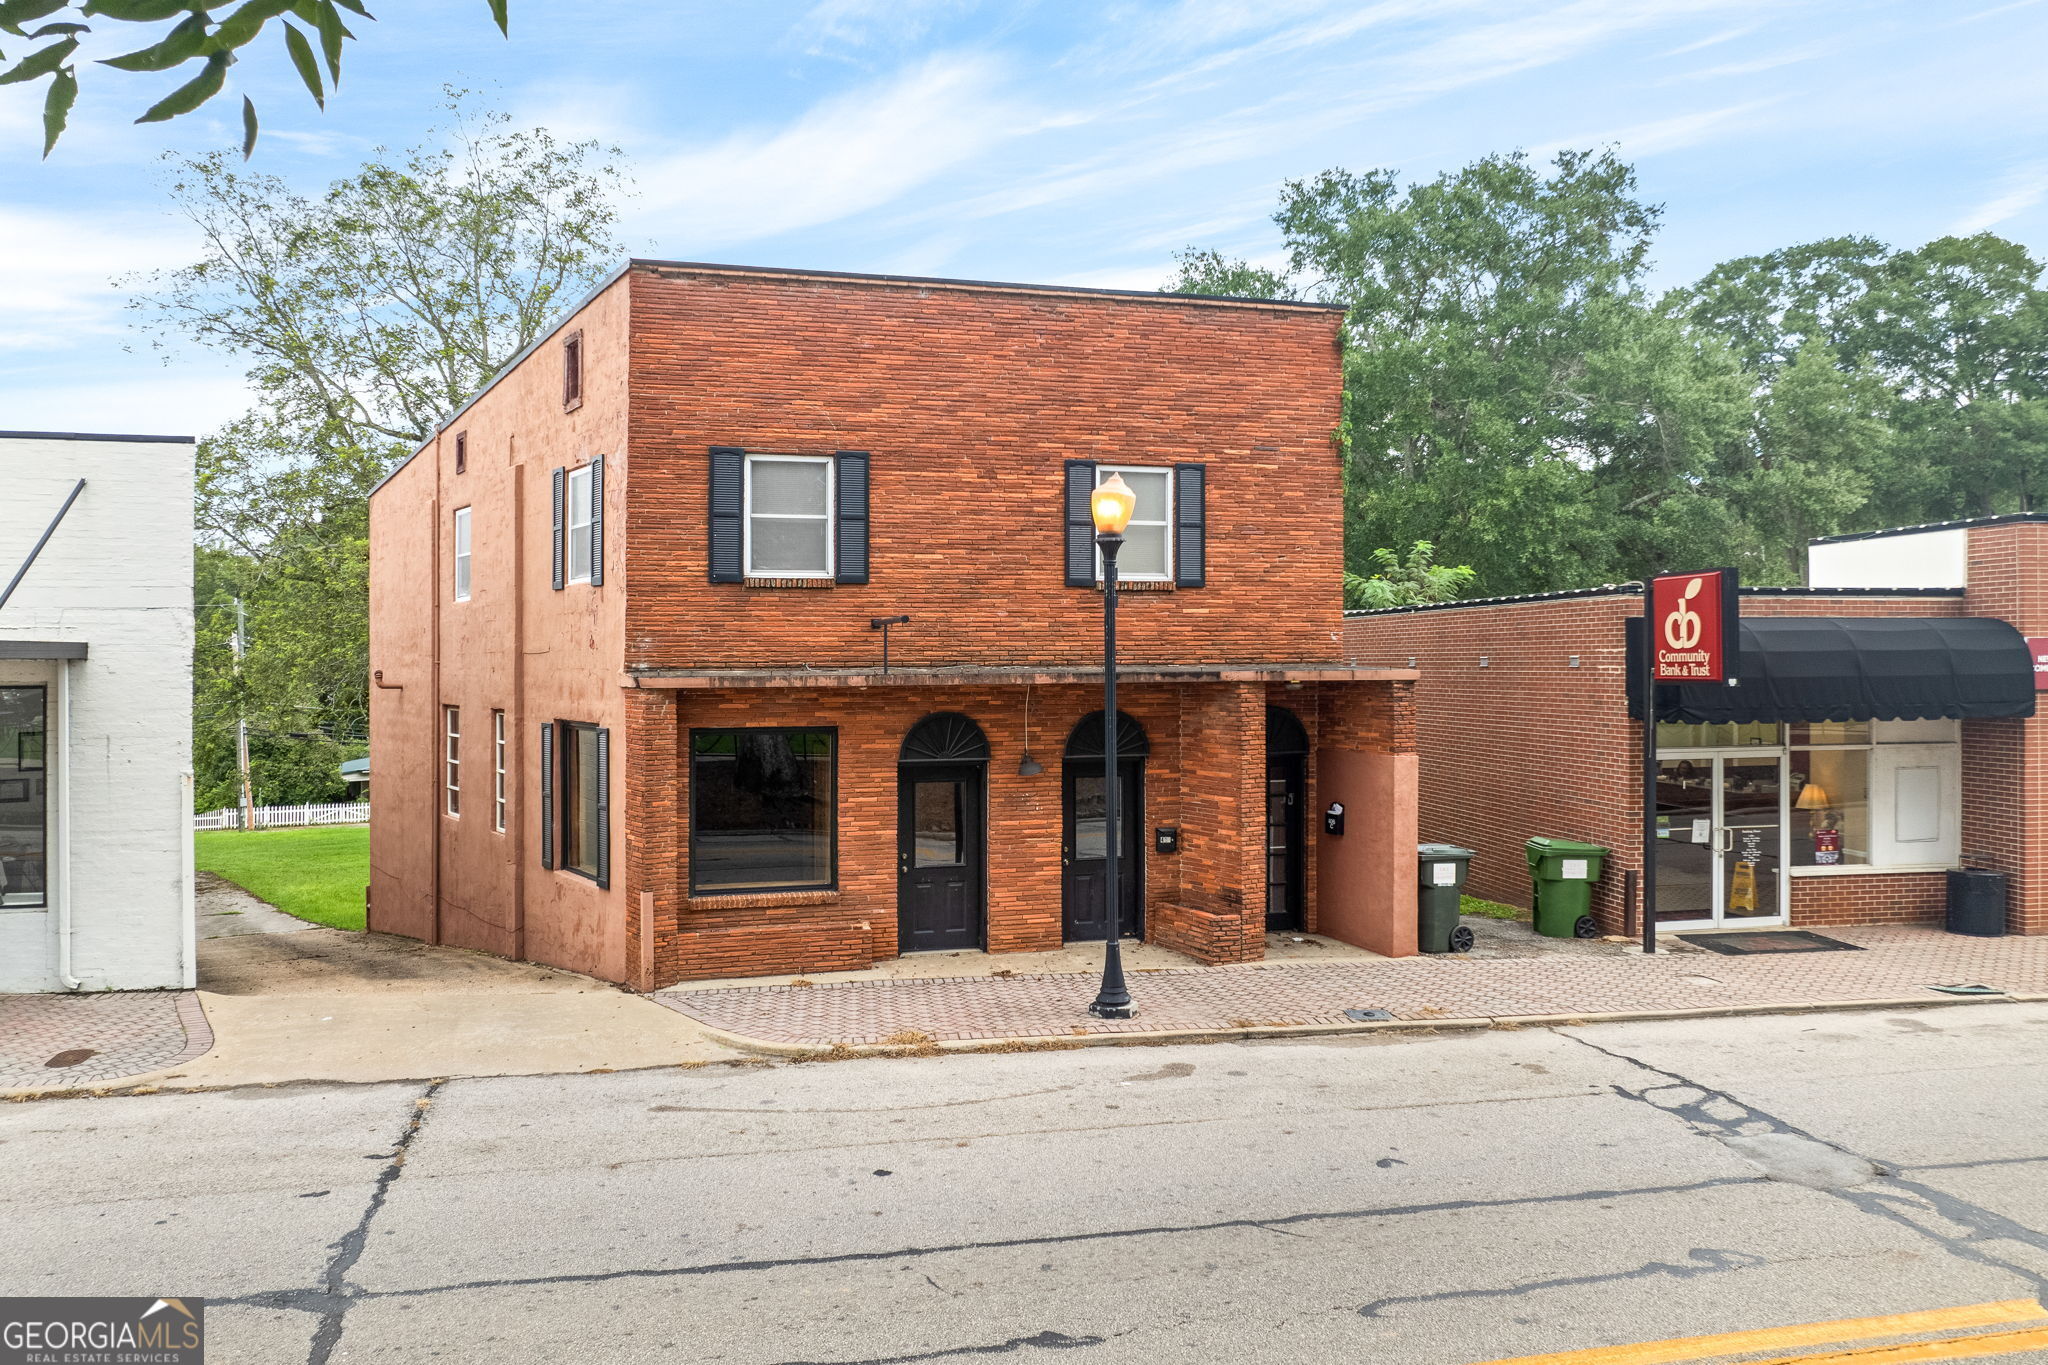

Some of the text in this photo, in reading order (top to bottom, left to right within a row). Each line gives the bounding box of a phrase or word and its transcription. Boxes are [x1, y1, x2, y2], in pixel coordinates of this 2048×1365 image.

[1659, 649, 1710, 665] Community
[1660, 663, 1711, 676] Bank & Trust
